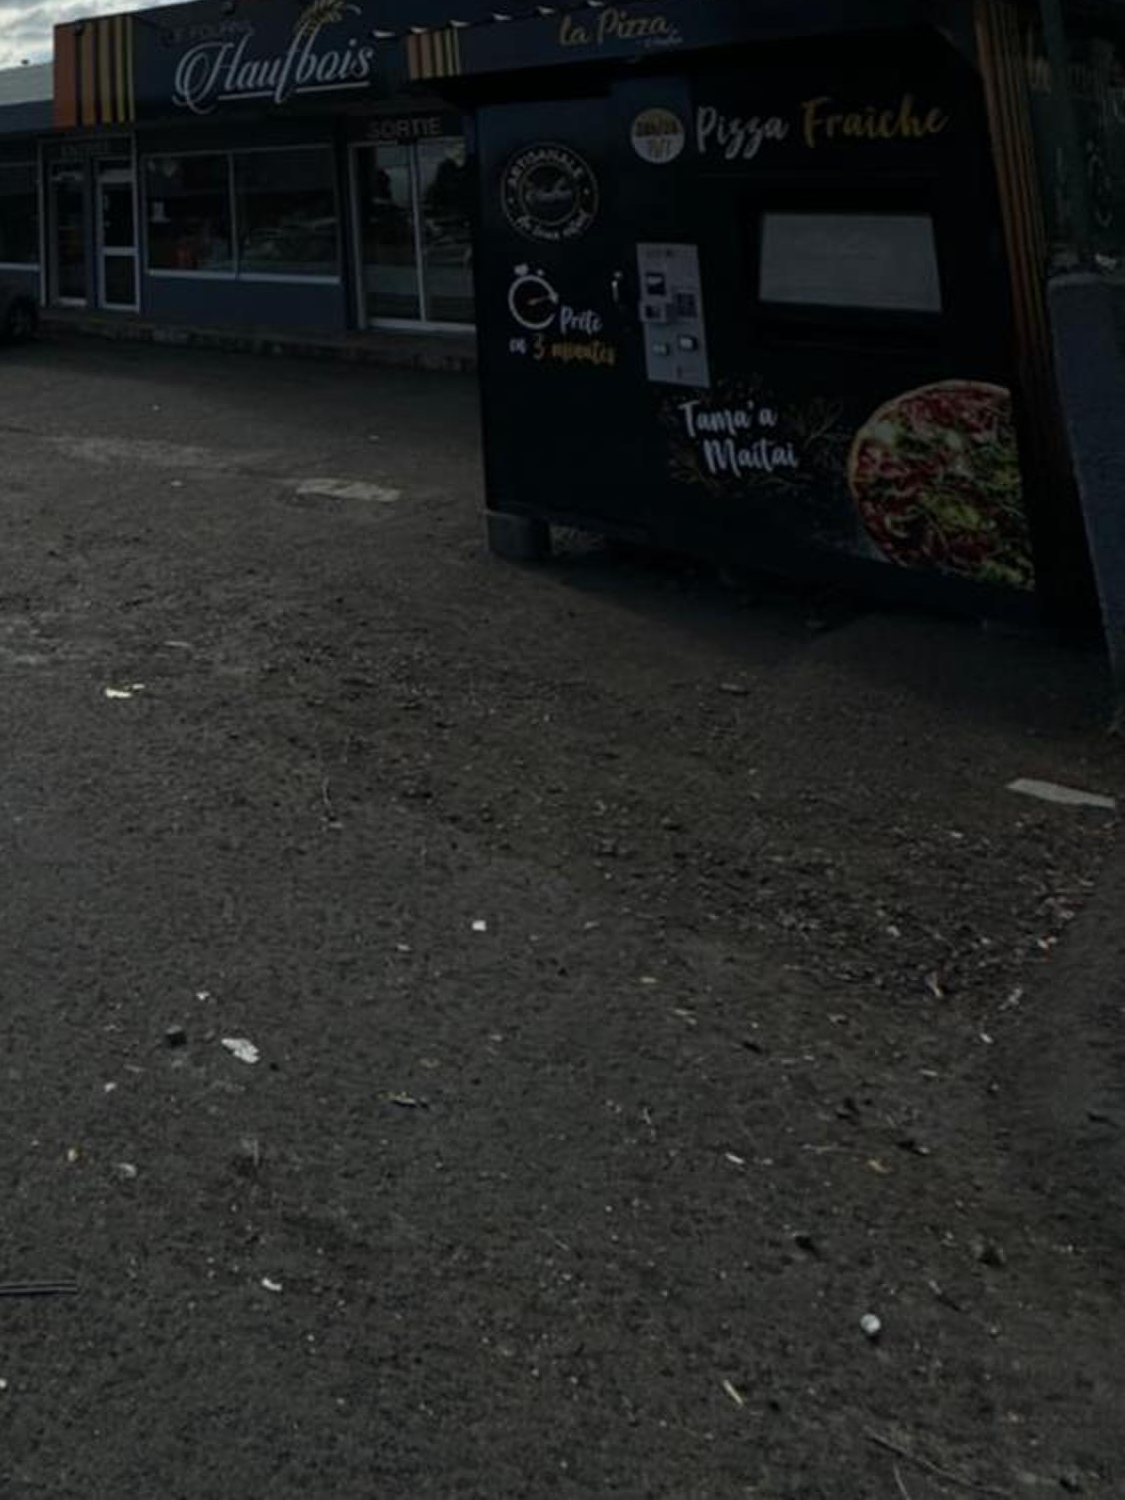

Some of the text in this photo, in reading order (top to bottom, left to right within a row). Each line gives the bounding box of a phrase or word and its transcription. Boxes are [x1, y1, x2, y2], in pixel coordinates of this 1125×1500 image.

[559, 14, 588, 46] la
[597, 6, 668, 45] Pizza
[364, 116, 443, 140] SORTIE
[696, 105, 791, 161] Pizza
